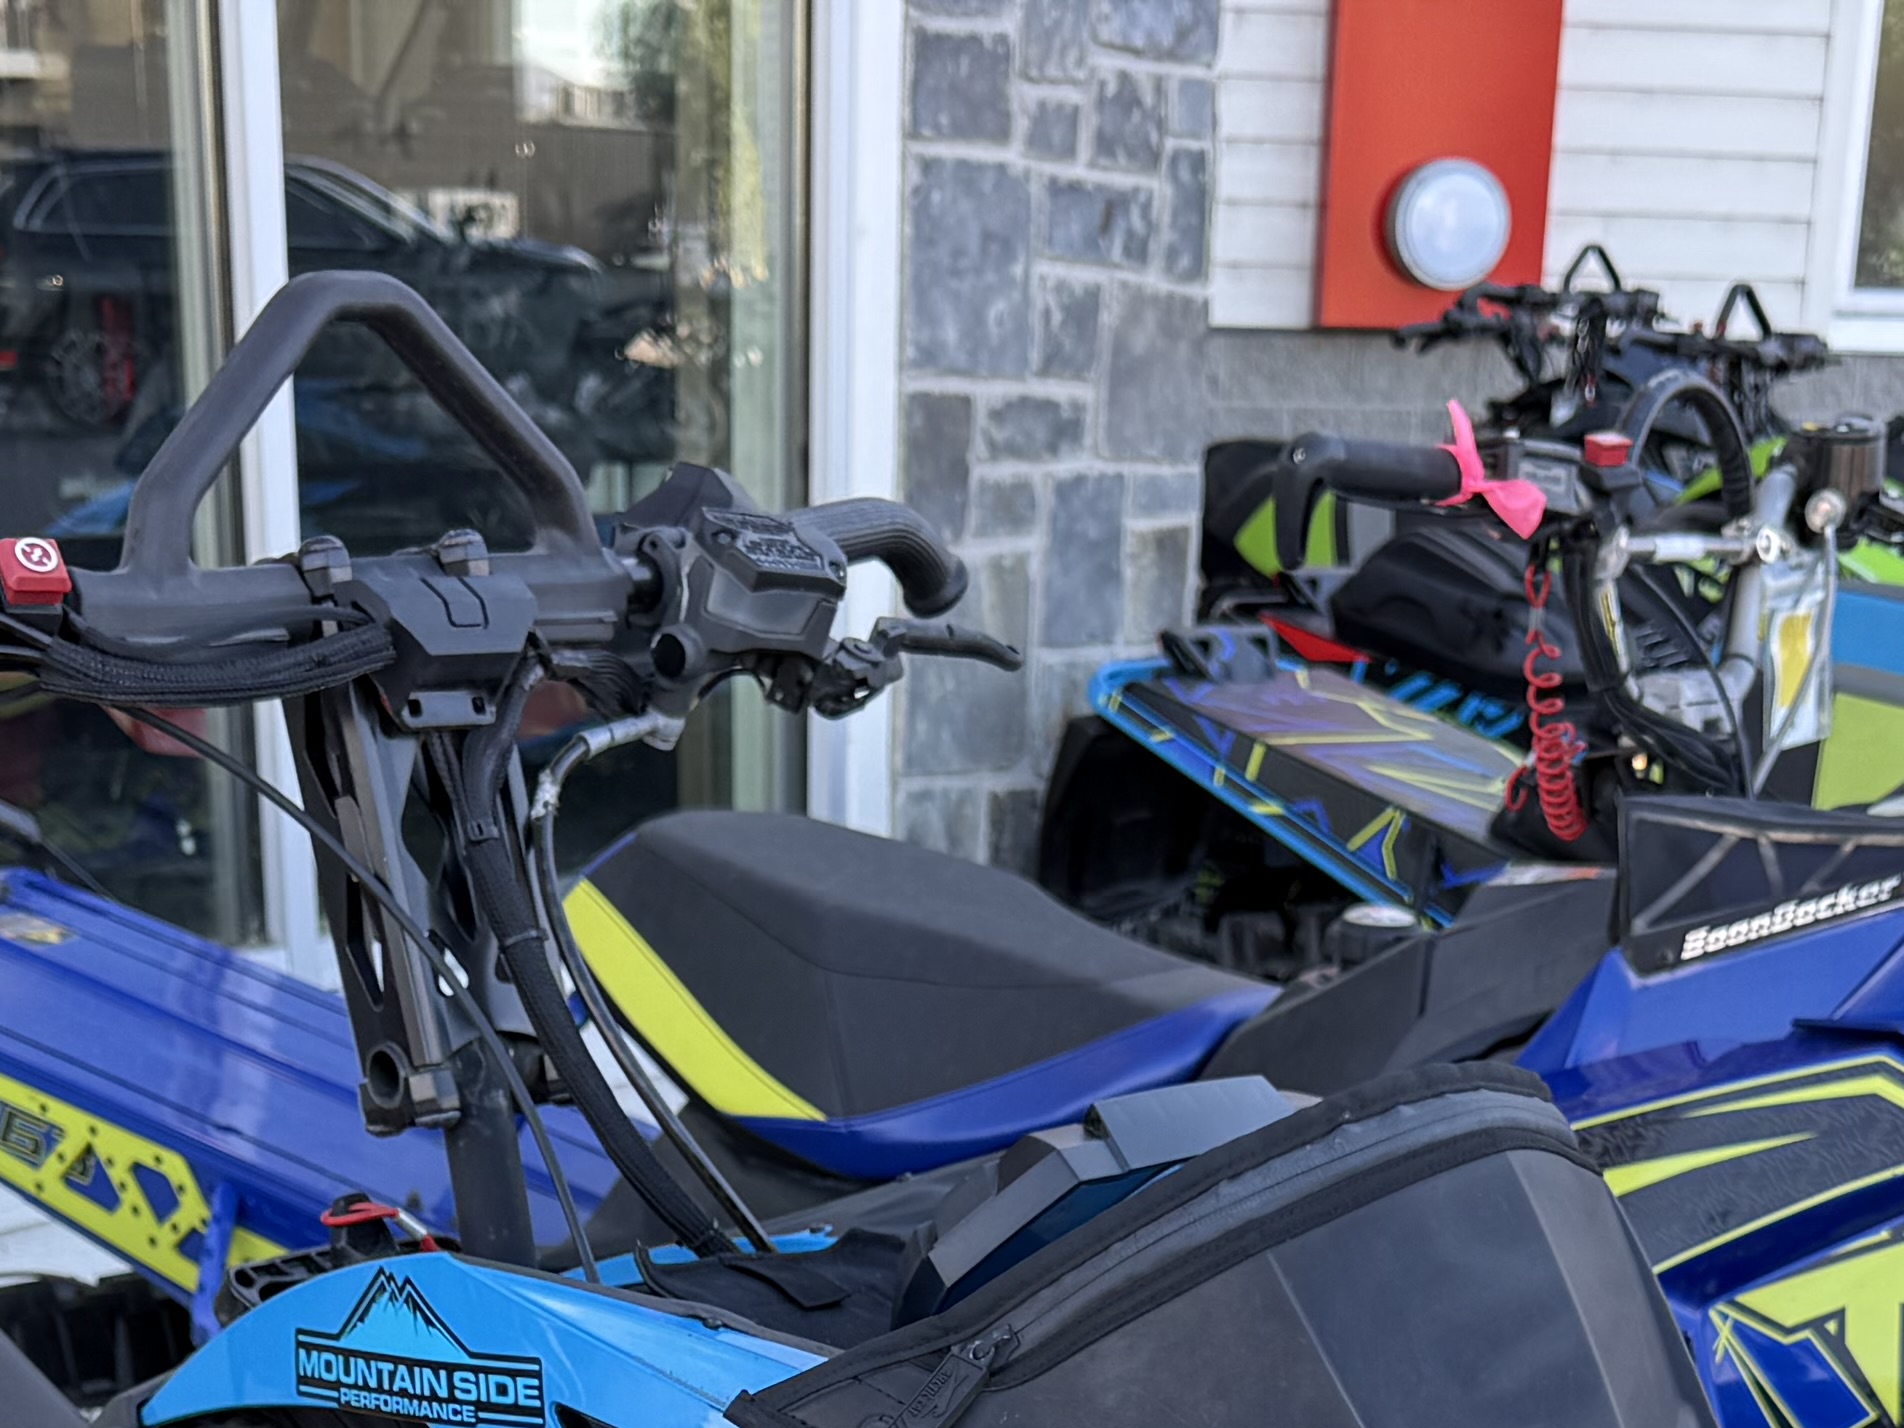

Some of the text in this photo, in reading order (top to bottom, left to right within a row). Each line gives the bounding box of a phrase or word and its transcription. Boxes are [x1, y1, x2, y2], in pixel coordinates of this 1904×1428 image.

[298, 1348, 543, 1408] MOUNTAIN SIDE
[339, 1387, 478, 1424] PERFORMANCE
